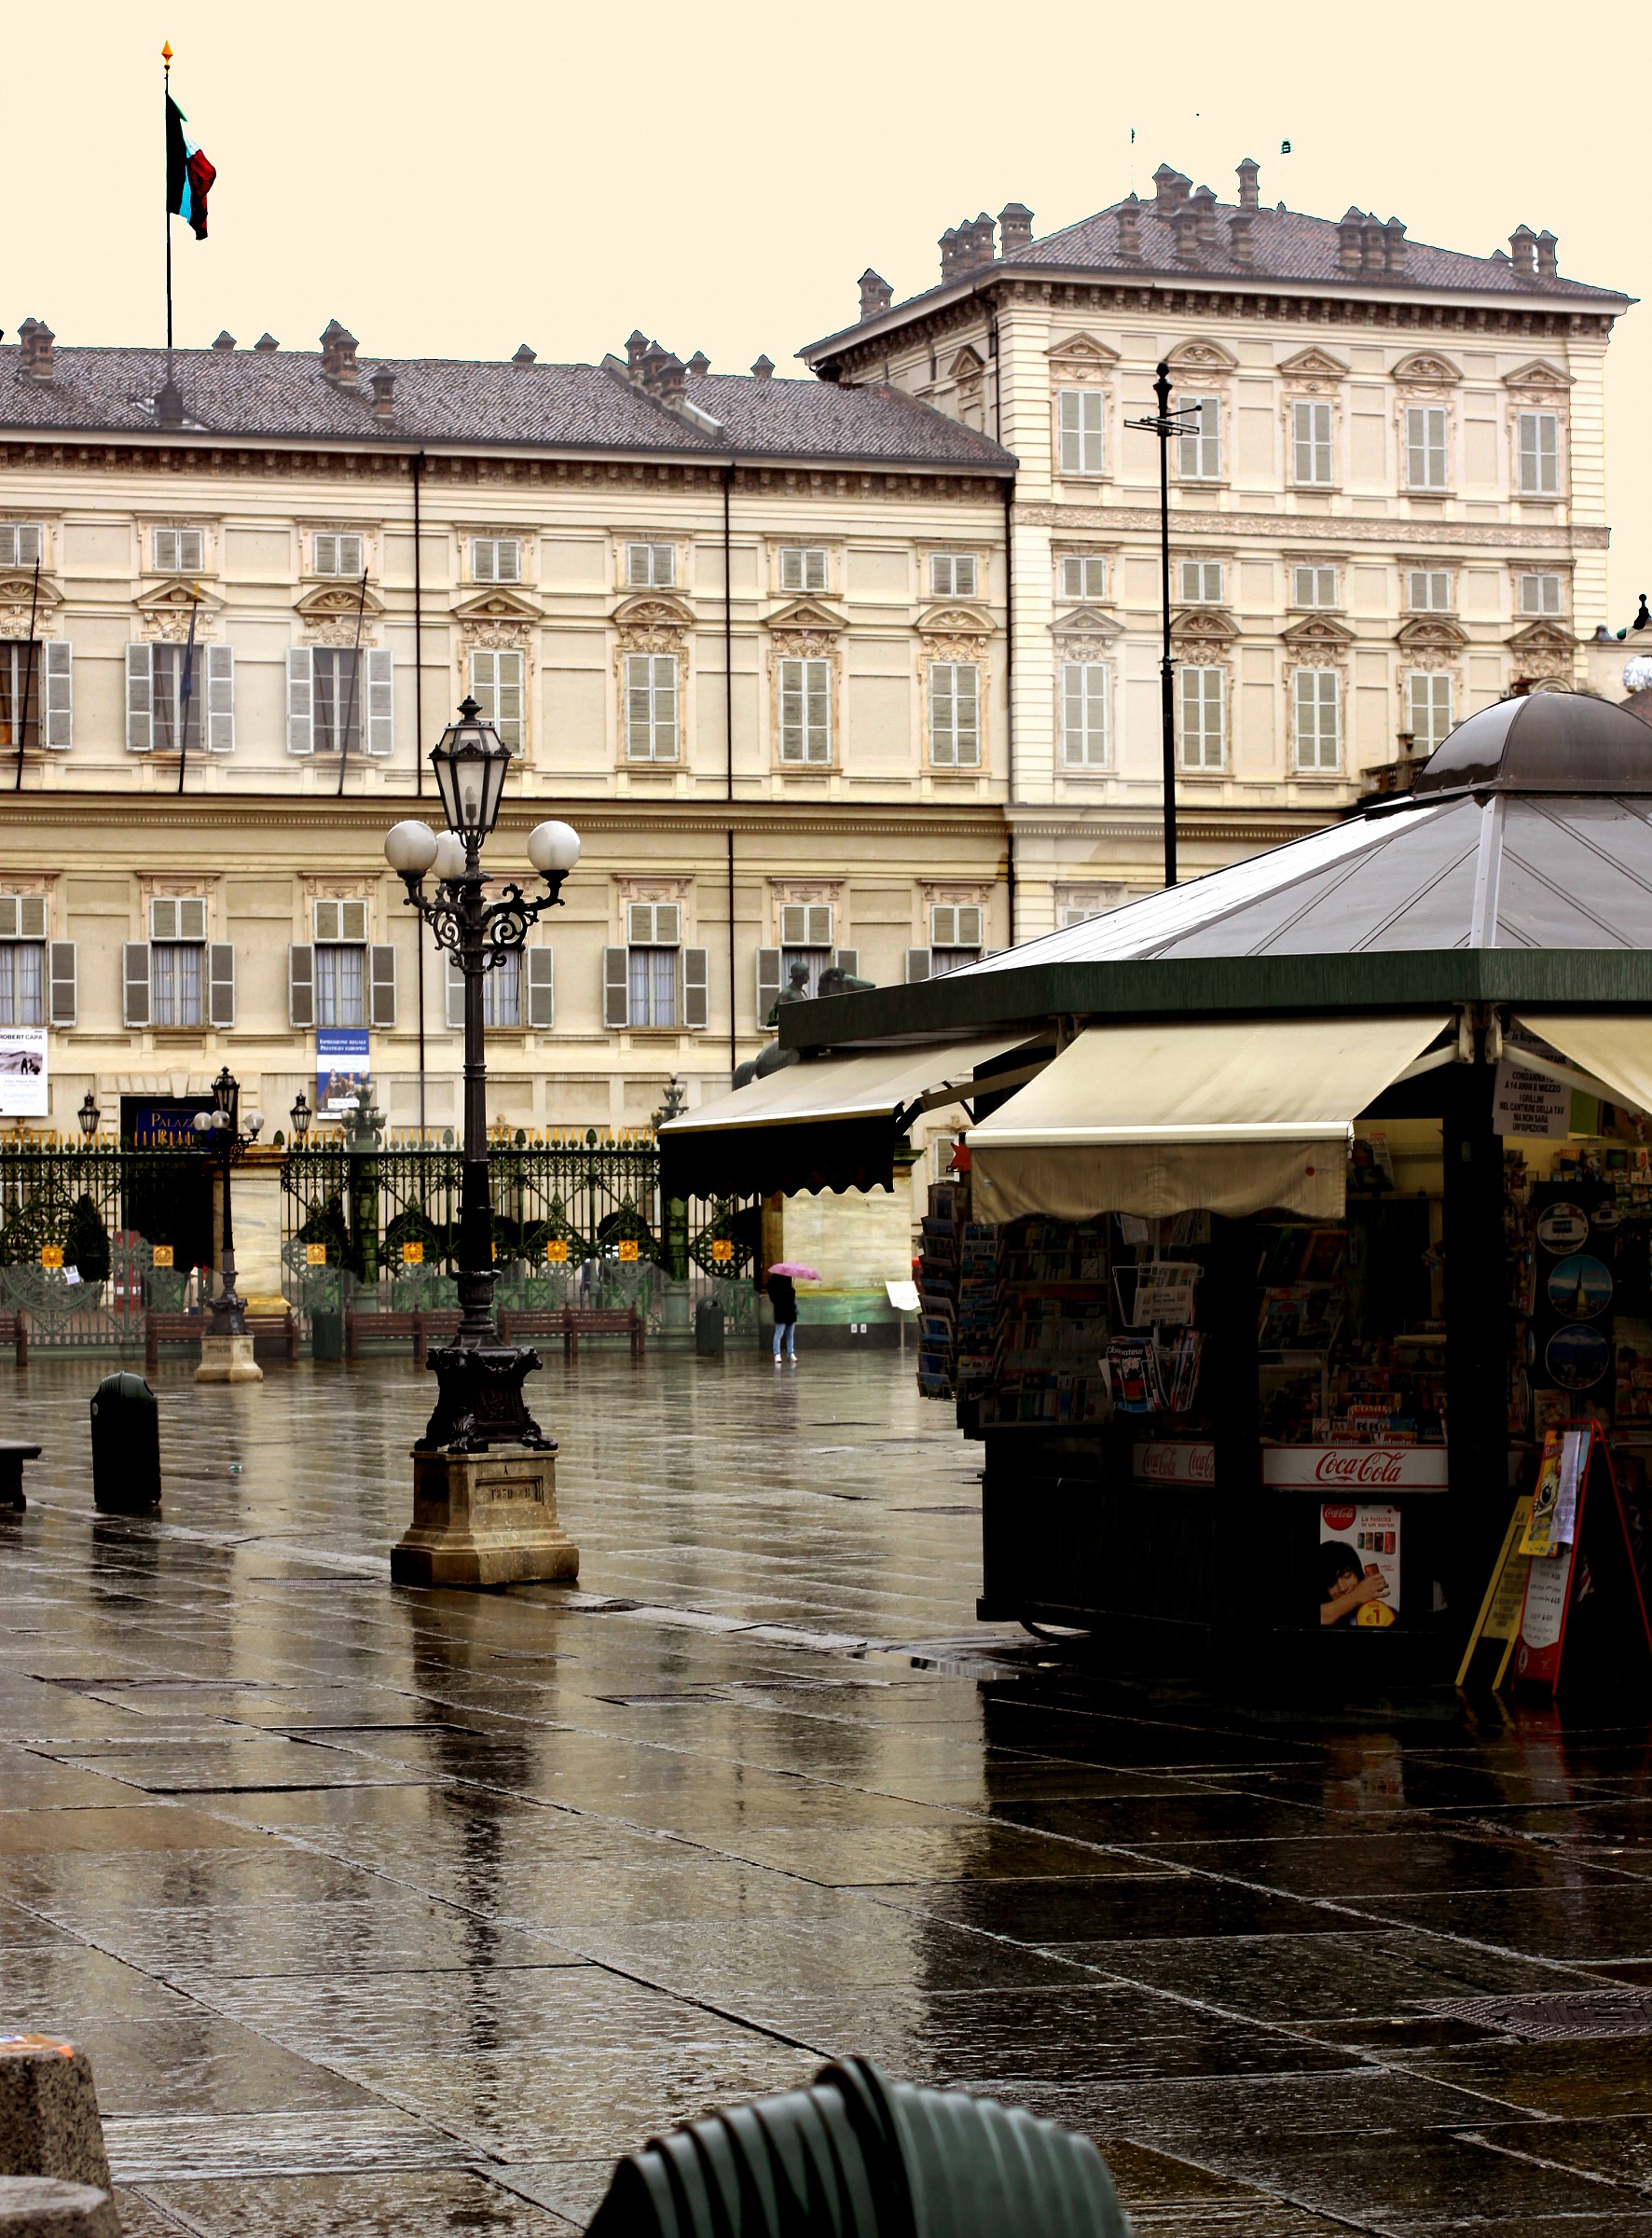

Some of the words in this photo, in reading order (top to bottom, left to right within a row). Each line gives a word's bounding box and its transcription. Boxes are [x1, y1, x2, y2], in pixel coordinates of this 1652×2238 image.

[1518, 1082, 1533, 1091] ANNI
[1538, 1084, 1562, 1093] MEZZO
[1509, 1102, 1535, 1113] CANTIERE
[1535, 1105, 1553, 1114] DELLA
[1554, 1106, 1565, 1114] TAV
[150, 1112, 196, 1127] PALAZZ
[1315, 1451, 1407, 1483] Coca-Cola
